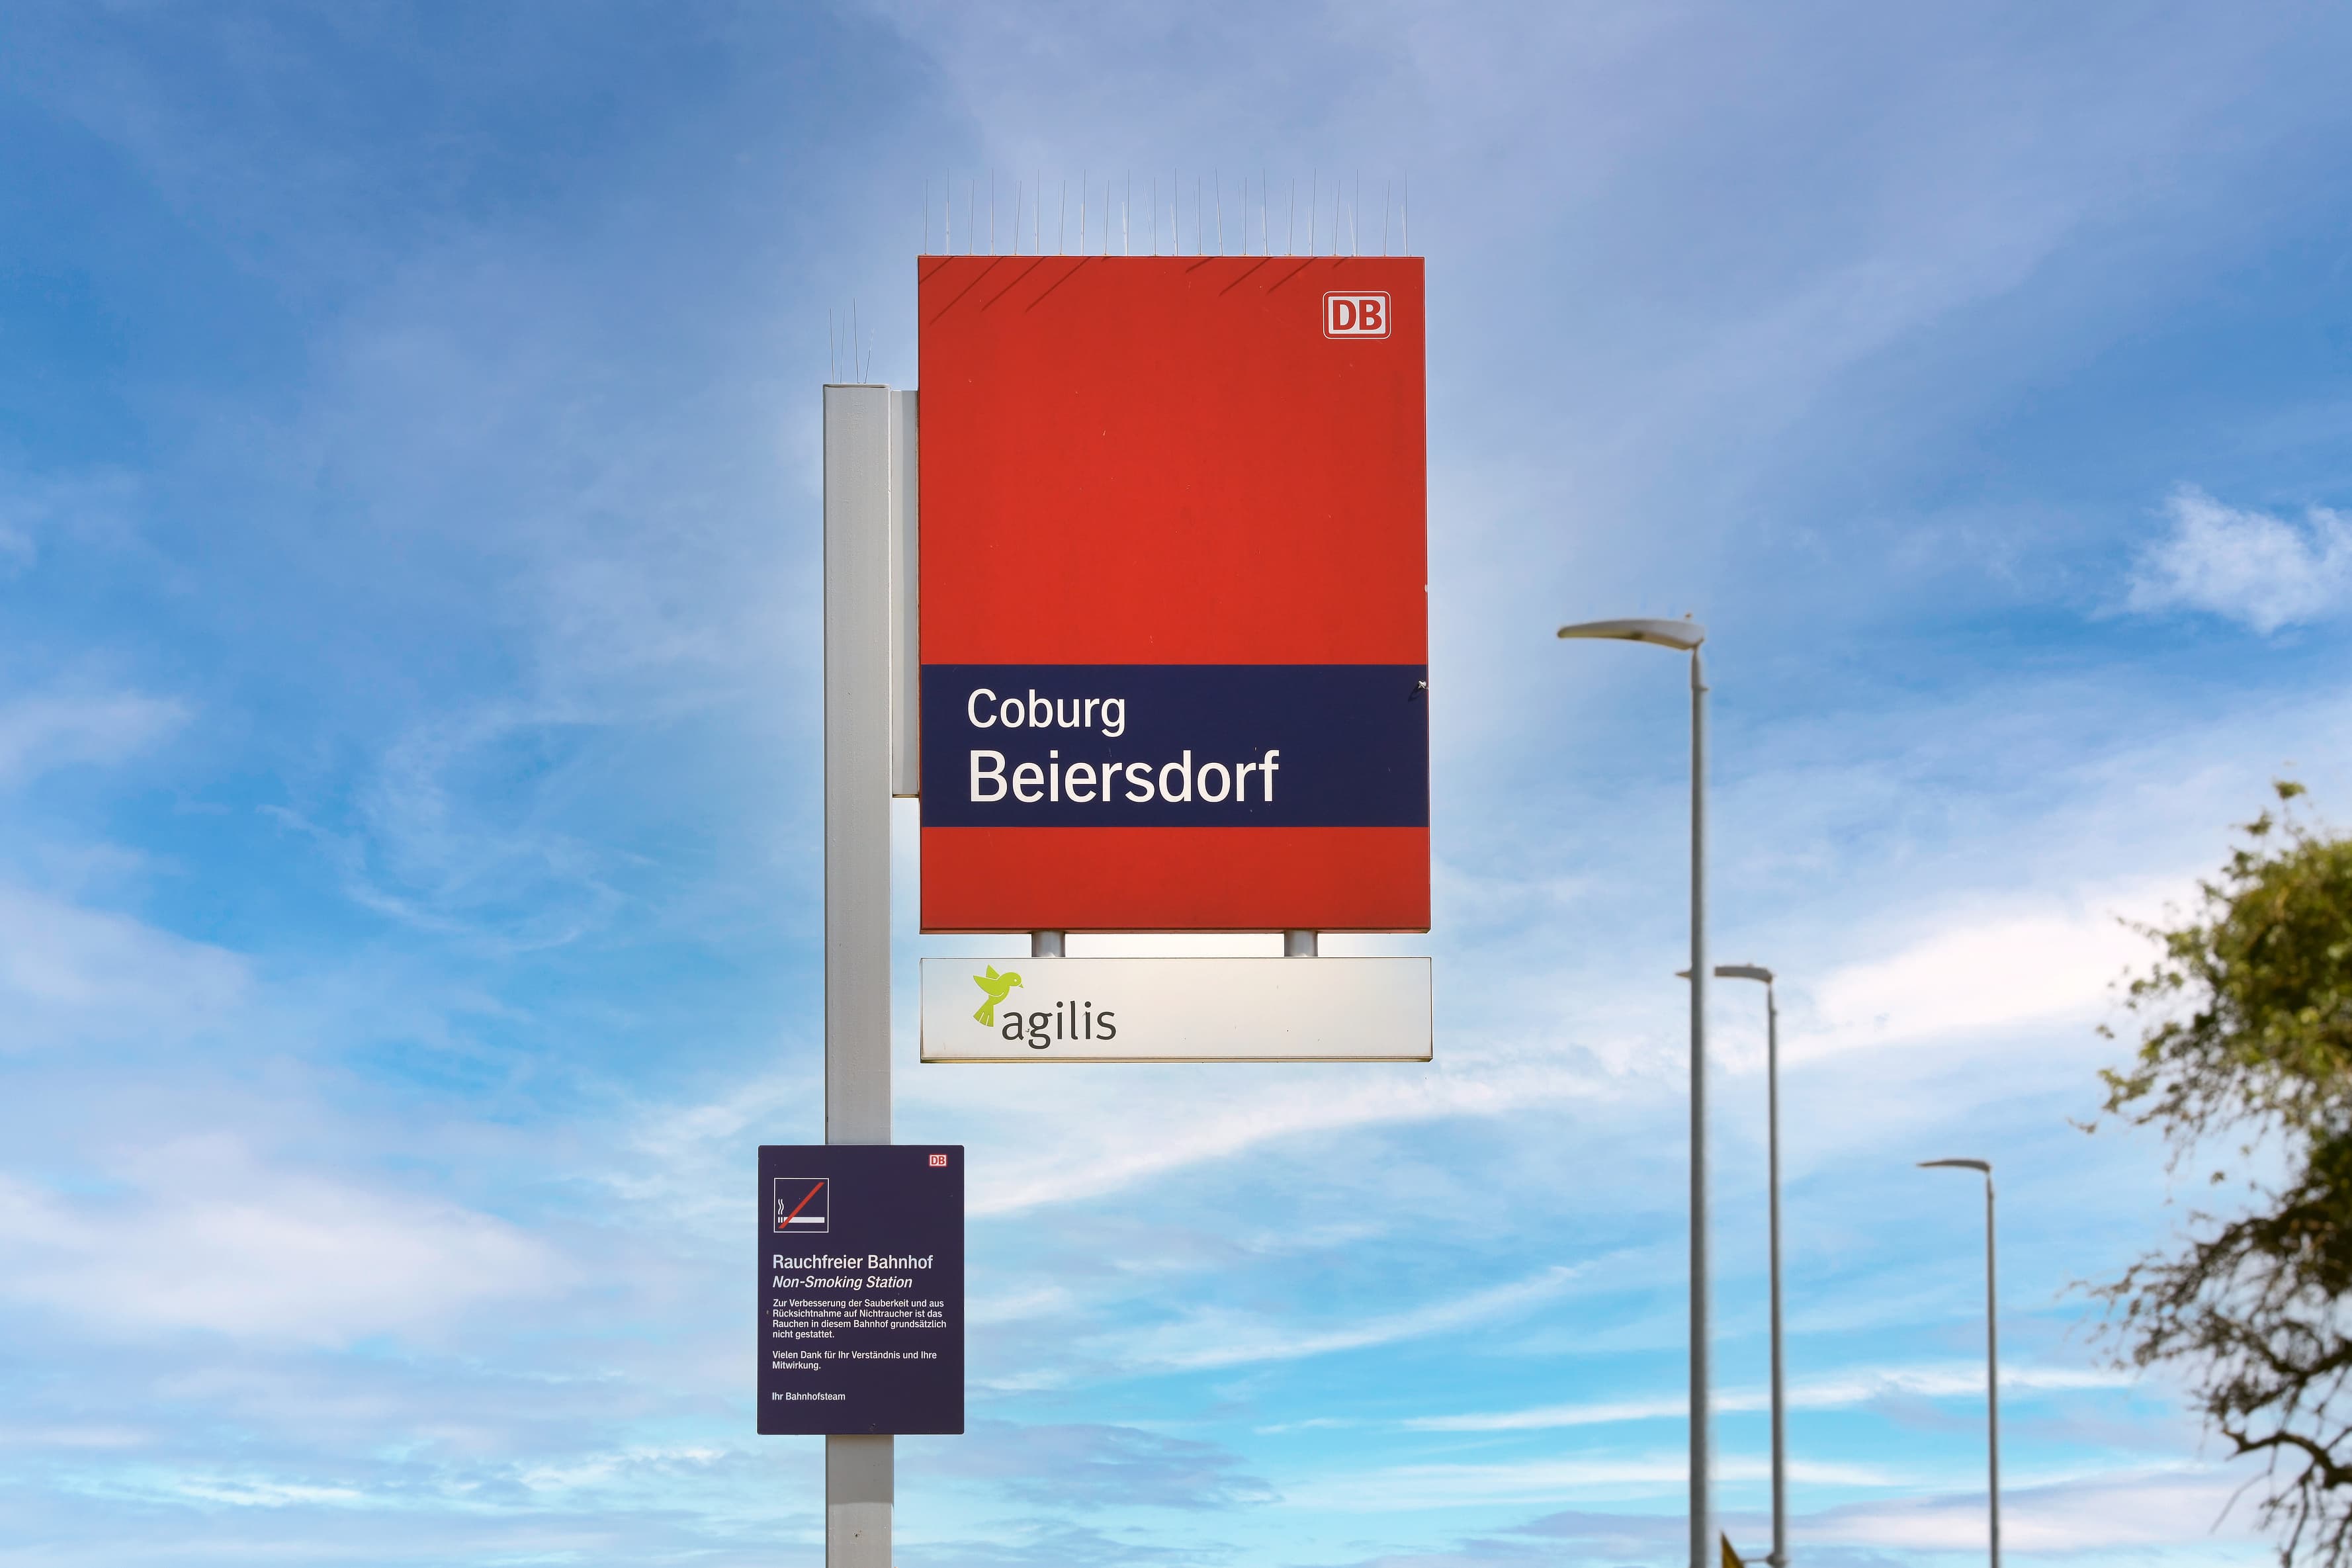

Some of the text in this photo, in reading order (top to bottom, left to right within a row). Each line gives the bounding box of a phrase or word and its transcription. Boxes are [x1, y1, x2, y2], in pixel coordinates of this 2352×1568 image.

[1332, 300, 1382, 331] DB
[968, 689, 1125, 737] Coburg
[971, 749, 1279, 803] Beiersdorf
[1002, 1000, 1117, 1049] agilis
[931, 1156, 945, 1165] DB
[773, 1254, 933, 1270] Rauchfreier Bahnhof
[772, 1275, 912, 1291] Non-Smoking Station
[773, 1298, 787, 1307] Zur
[789, 1298, 846, 1309] Verbesserung
[848, 1299, 862, 1307] der
[864, 1299, 908, 1307] Sauberkeit
[911, 1299, 926, 1307] und
[773, 1309, 942, 1318] Rücksichtnahme auf Nichtraucher ist das
[772, 1319, 946, 1330] Rauchen in diesem Bahnhof grundsätzlich
[772, 1329, 834, 1340] nicht gestattet.
[772, 1350, 937, 1359] Vielen Dank für Ihr Verständnis und Ihre
[772, 1360, 820, 1371] Mitwirkung.
[772, 1391, 845, 1401] Ihr Bahnhofsteam
